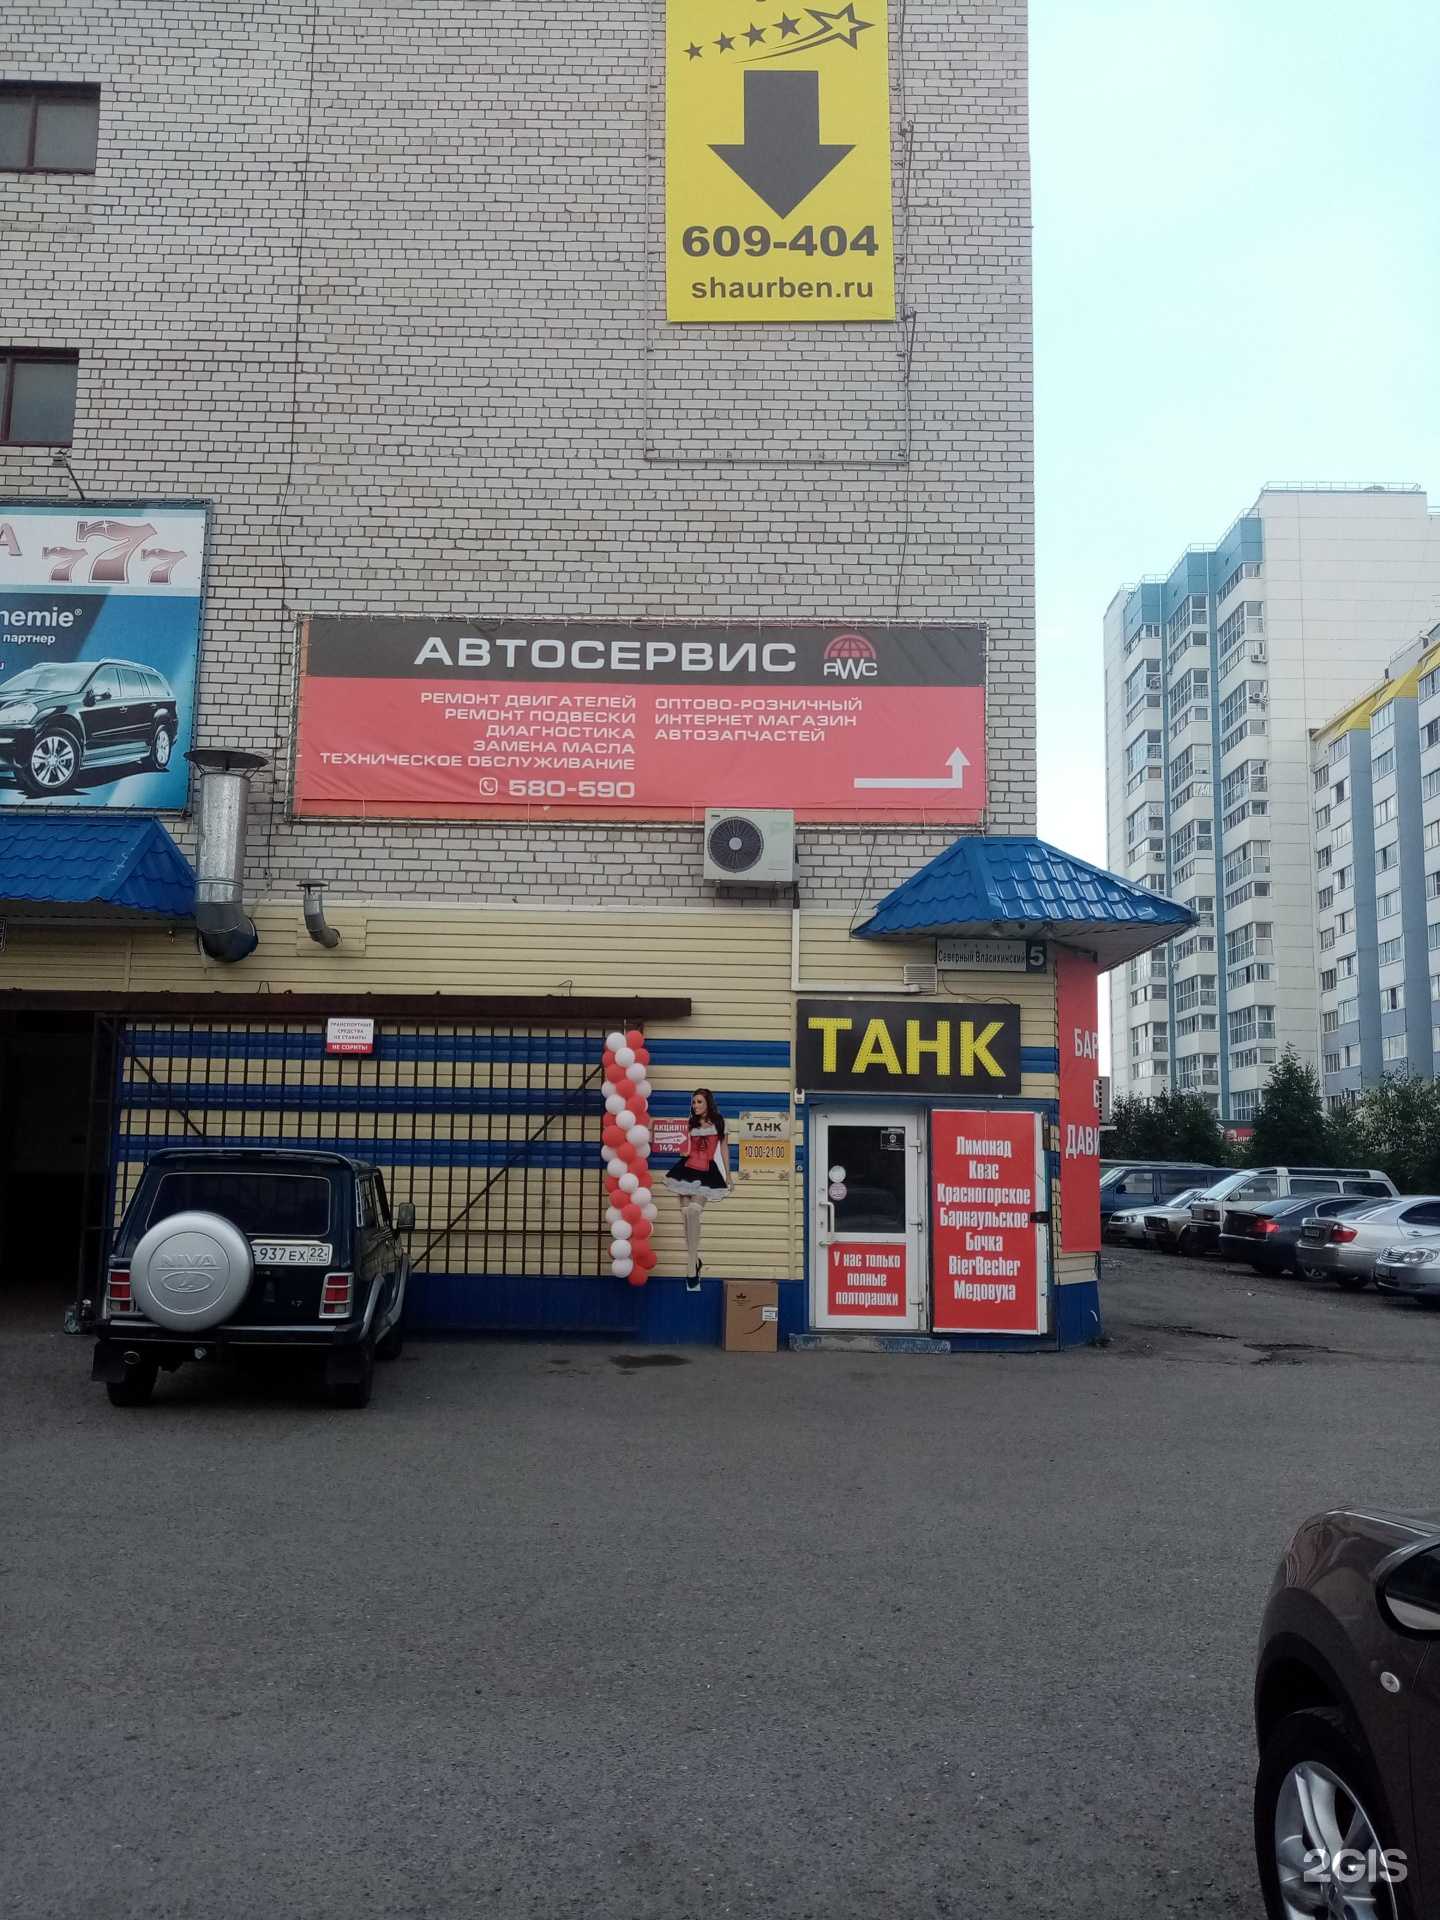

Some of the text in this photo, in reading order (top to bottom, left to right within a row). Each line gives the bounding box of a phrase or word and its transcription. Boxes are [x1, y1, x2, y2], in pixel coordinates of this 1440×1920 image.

[682, 225, 879, 257] 609-404
[691, 277, 873, 298] shaurben.ru
[3, 633, 56, 645] партнер
[413, 637, 878, 680] АВТОСЕРВИС AWC
[420, 692, 636, 708] РЕМОНТ ДВИГАТЕЛЕЙ
[655, 697, 863, 712] ОПТОВО-РОЗНИЧНЫЙ
[444, 708, 636, 724] РЕМОНТ ПОДВЕСКИ
[655, 714, 857, 727] ИНТЕРНЕТ МАГАЗИН
[486, 725, 635, 740] ДИАГНОСТИКА
[655, 728, 825, 742] АВТОЗАПЧАСТЕЙ
[473, 740, 635, 755] ЗАМЕНА МАСЛА
[320, 752, 635, 770] ТЕХНИЧЕСКОЕ ОБСЛУЖИВАНИЕ
[508, 780, 635, 799] 580-590
[1029, 946, 1045, 966] 5
[808, 1017, 1006, 1078] ТАНК
[746, 1122, 782, 1132] ТАНК
[956, 1136, 1013, 1158] Лимонад
[968, 1160, 999, 1180] Квас
[937, 1183, 1031, 1206] Красногорское
[940, 1208, 1029, 1229] Барнаульское
[965, 1232, 1004, 1252] Бочка
[160, 1254, 217, 1267] NIVA
[310, 1247, 324, 1258] 22
[833, 1251, 901, 1269] У нас только
[949, 1256, 1021, 1277] BierBecher
[847, 1272, 887, 1288] полные
[835, 1290, 899, 1309] полторашки
[954, 1280, 1017, 1304] Медовуха
